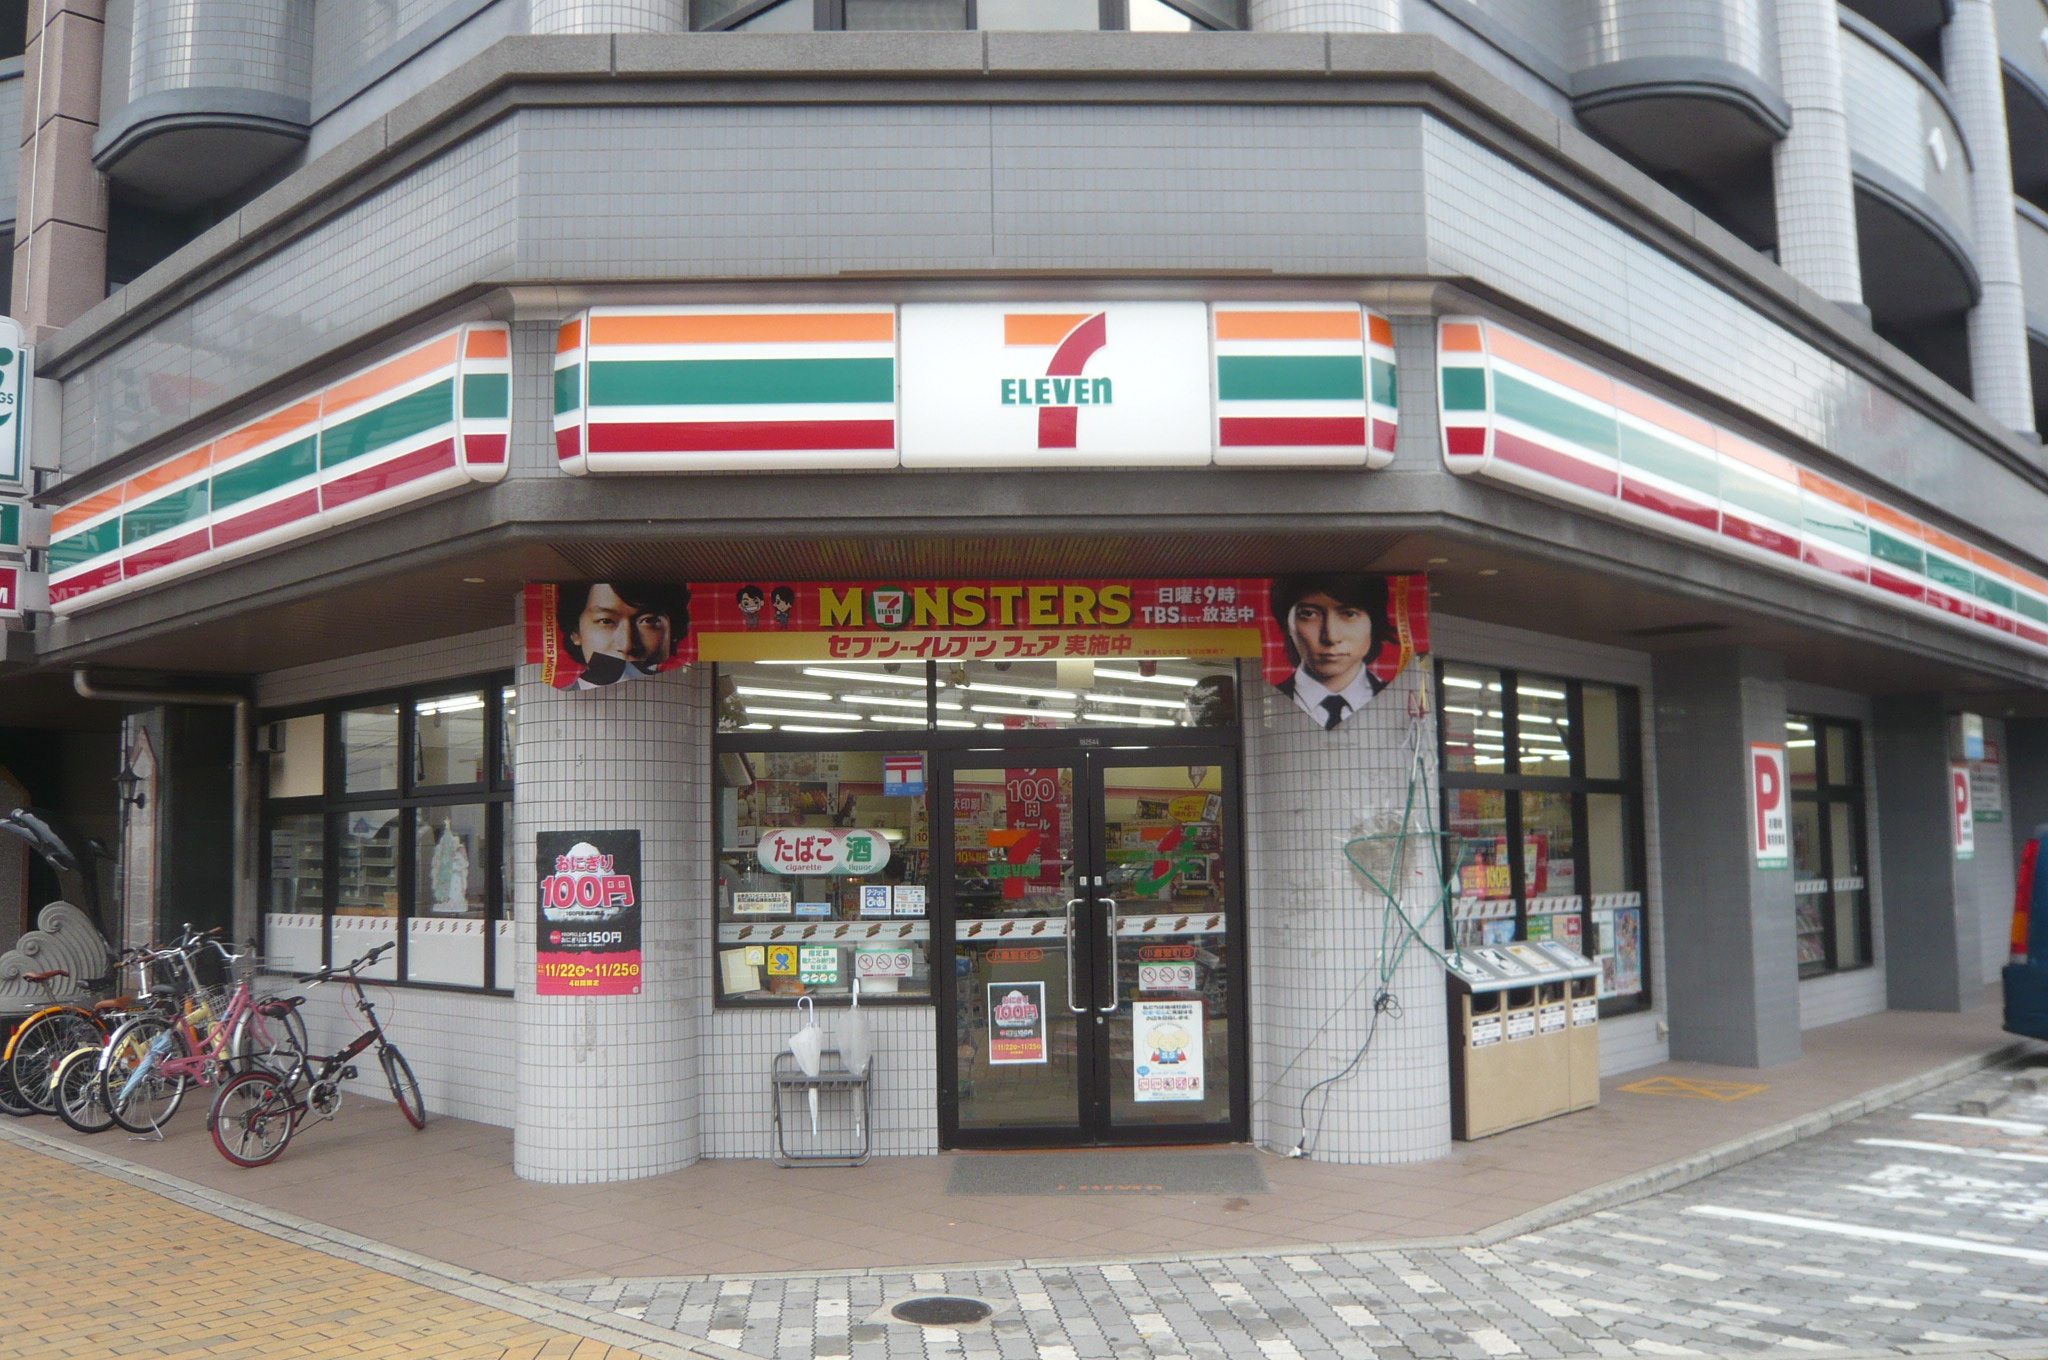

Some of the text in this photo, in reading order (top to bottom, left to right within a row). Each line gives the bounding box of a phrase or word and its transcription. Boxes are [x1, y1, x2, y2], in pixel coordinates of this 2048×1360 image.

[1003, 311, 1107, 449] 7
[1754, 755, 1781, 850] P
[1953, 773, 1969, 846] P
[774, 836, 834, 863] たばこ
[846, 837, 872, 863] 酒
[555, 854, 614, 873] おにぎり
[785, 864, 822, 872] cigarette
[849, 864, 872, 872] liquor
[541, 875, 635, 908] 100円
